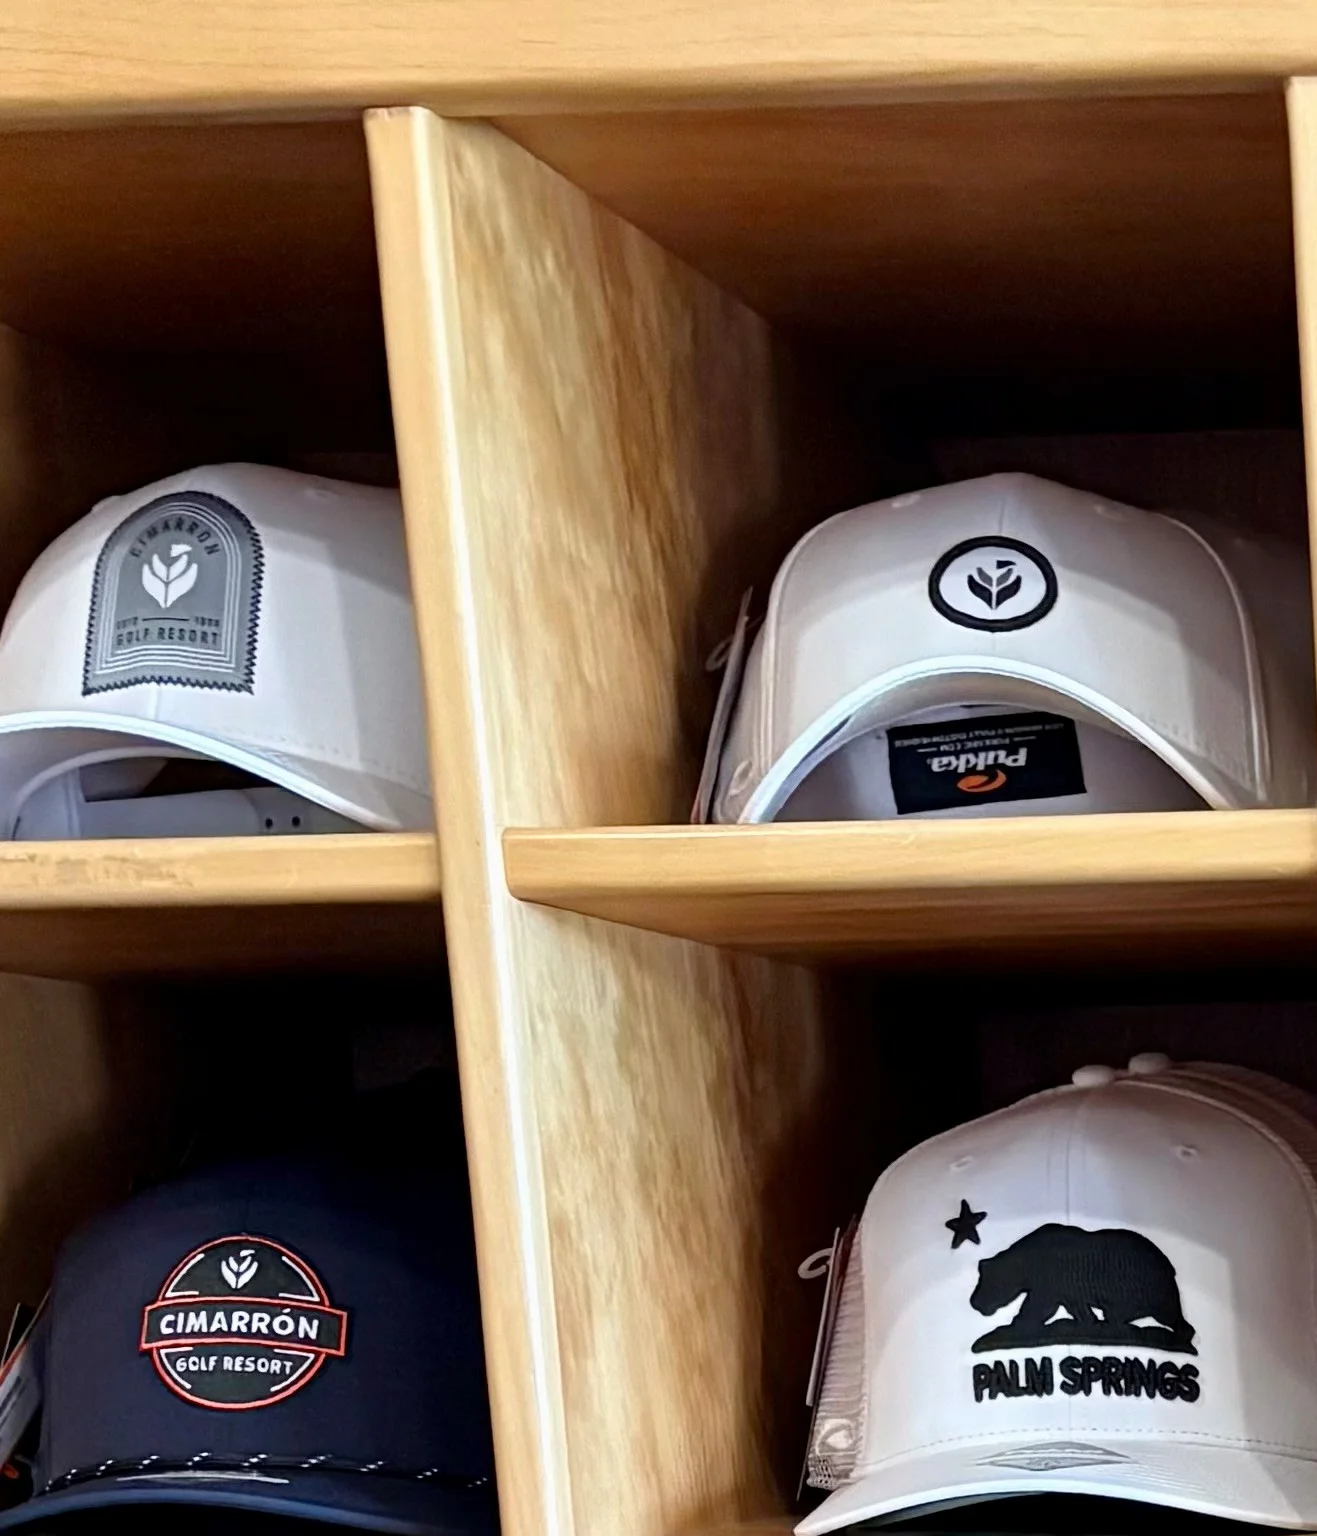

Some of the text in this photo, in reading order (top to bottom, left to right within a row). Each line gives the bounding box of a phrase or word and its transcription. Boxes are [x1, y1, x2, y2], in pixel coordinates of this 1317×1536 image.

[159, 1306, 319, 1341] CIMARRÓN
[175, 1355, 294, 1376] GOLF RESORT
[973, 1356, 1201, 1404] PALM SPRINGS
